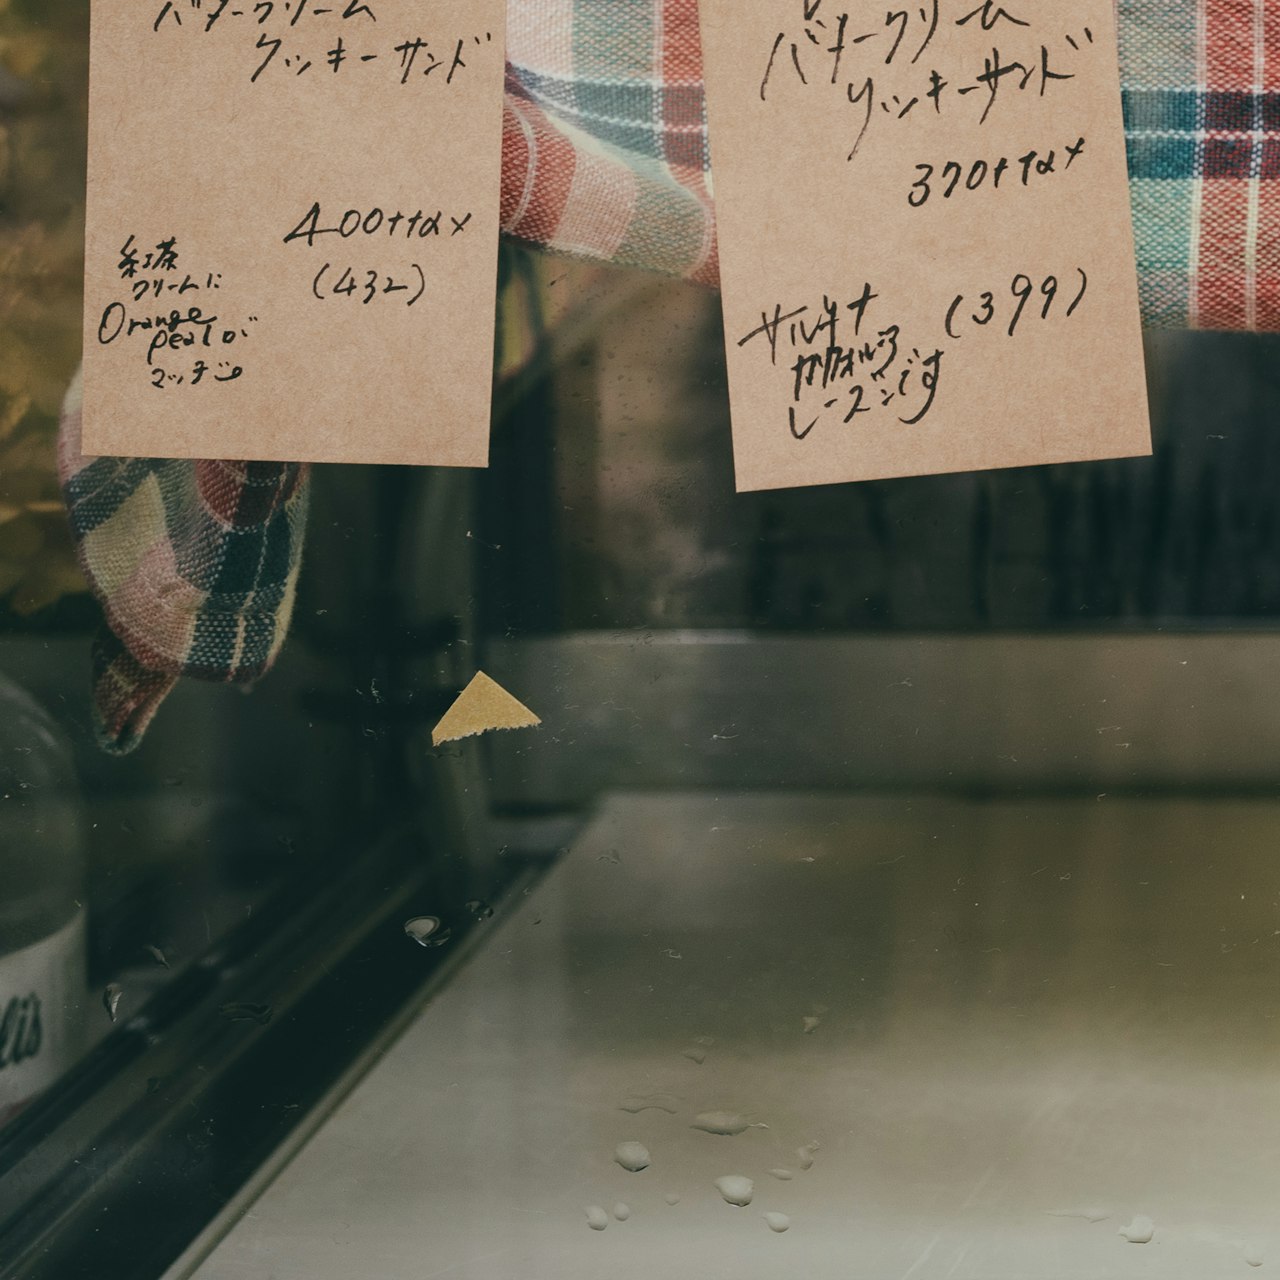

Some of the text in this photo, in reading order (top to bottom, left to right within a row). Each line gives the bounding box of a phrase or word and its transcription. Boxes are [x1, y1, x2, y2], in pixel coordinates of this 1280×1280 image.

[250, 32, 492, 86] クッキーサンド
[846, 27, 1092, 161] クッキーサンド
[118, 234, 180, 280] 紅茶
[132, 272, 223, 301] クリームに
[312, 262, 427, 306] (432)
[946, 267, 1089, 339] (399)
[98, 302, 218, 345] Orange
